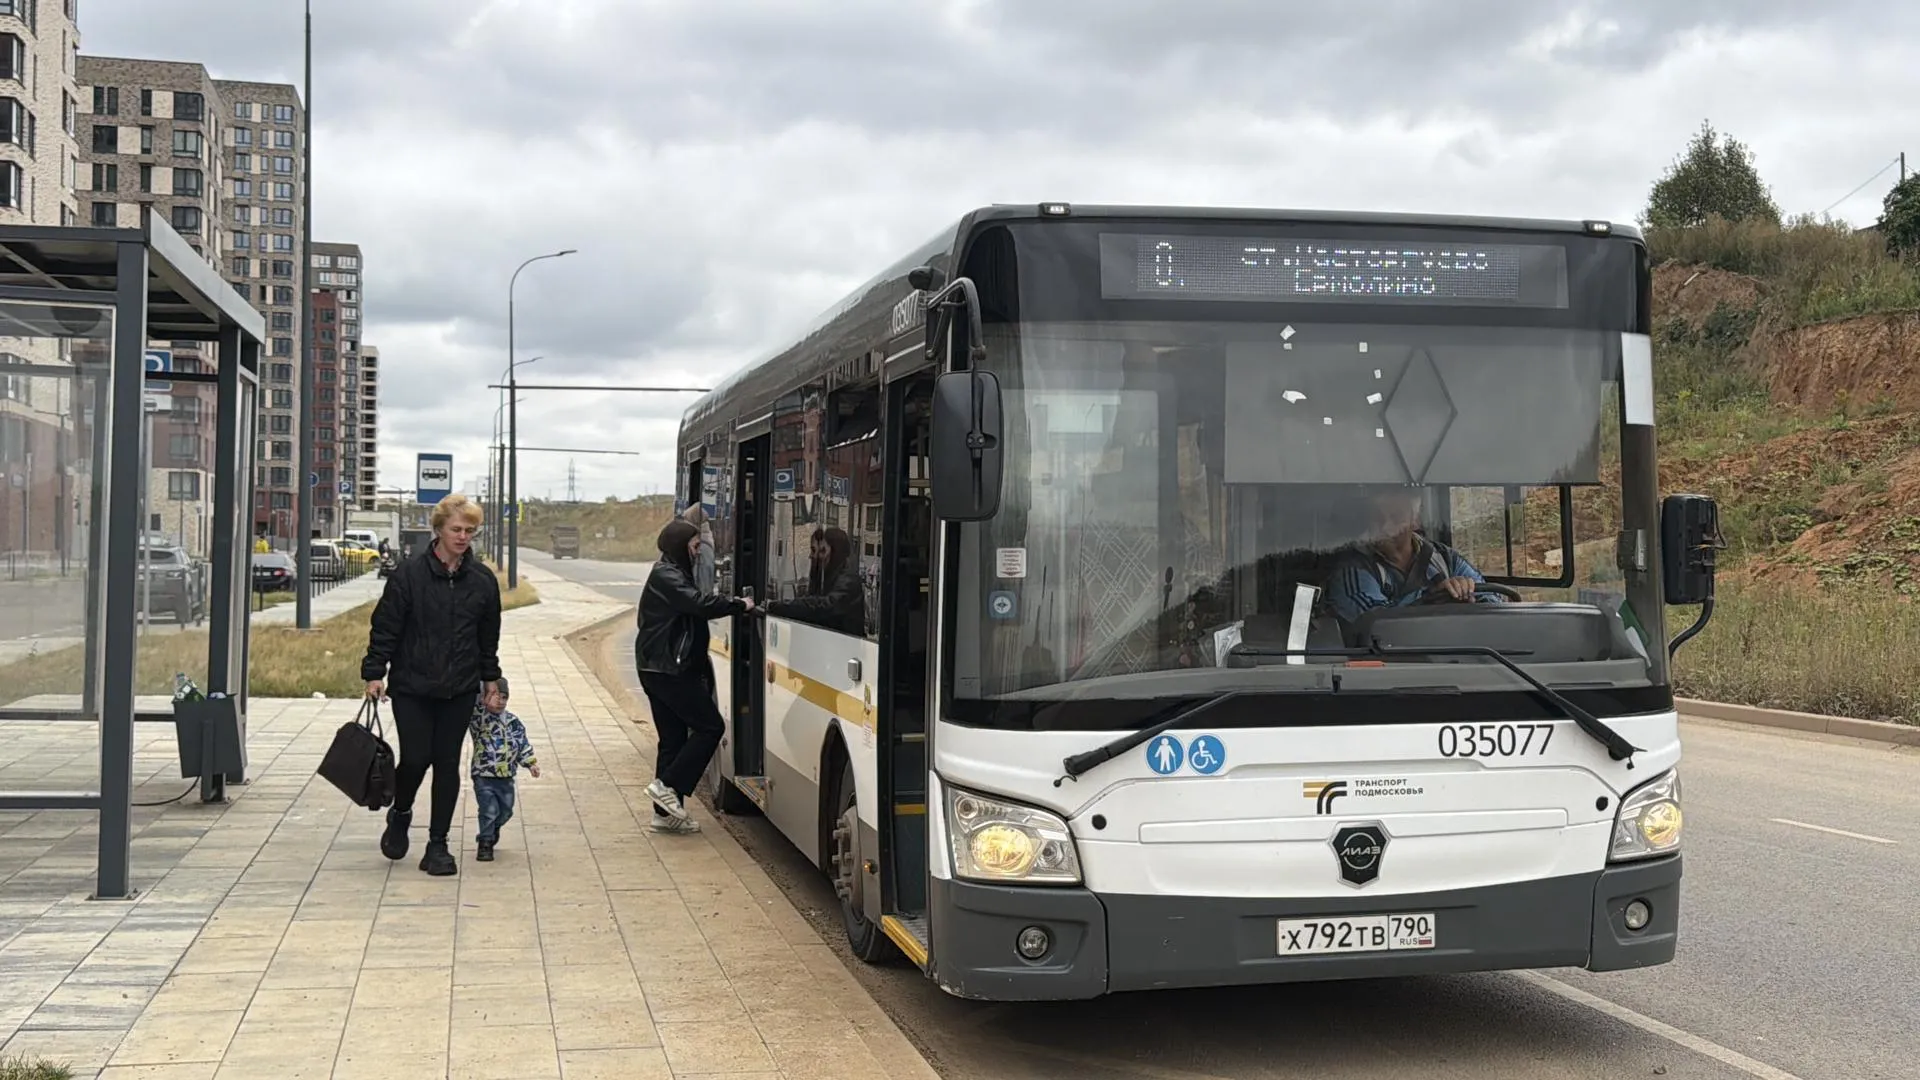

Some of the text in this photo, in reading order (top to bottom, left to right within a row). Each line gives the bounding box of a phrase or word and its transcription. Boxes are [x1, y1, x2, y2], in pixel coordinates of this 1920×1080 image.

[1438, 724, 1554, 757] 035077
[1355, 778, 1408, 787] ТРАНСПОРТ
[1355, 787, 1424, 797] ПОДМОСКОВЬЯ
[1391, 916, 1429, 937] 790
